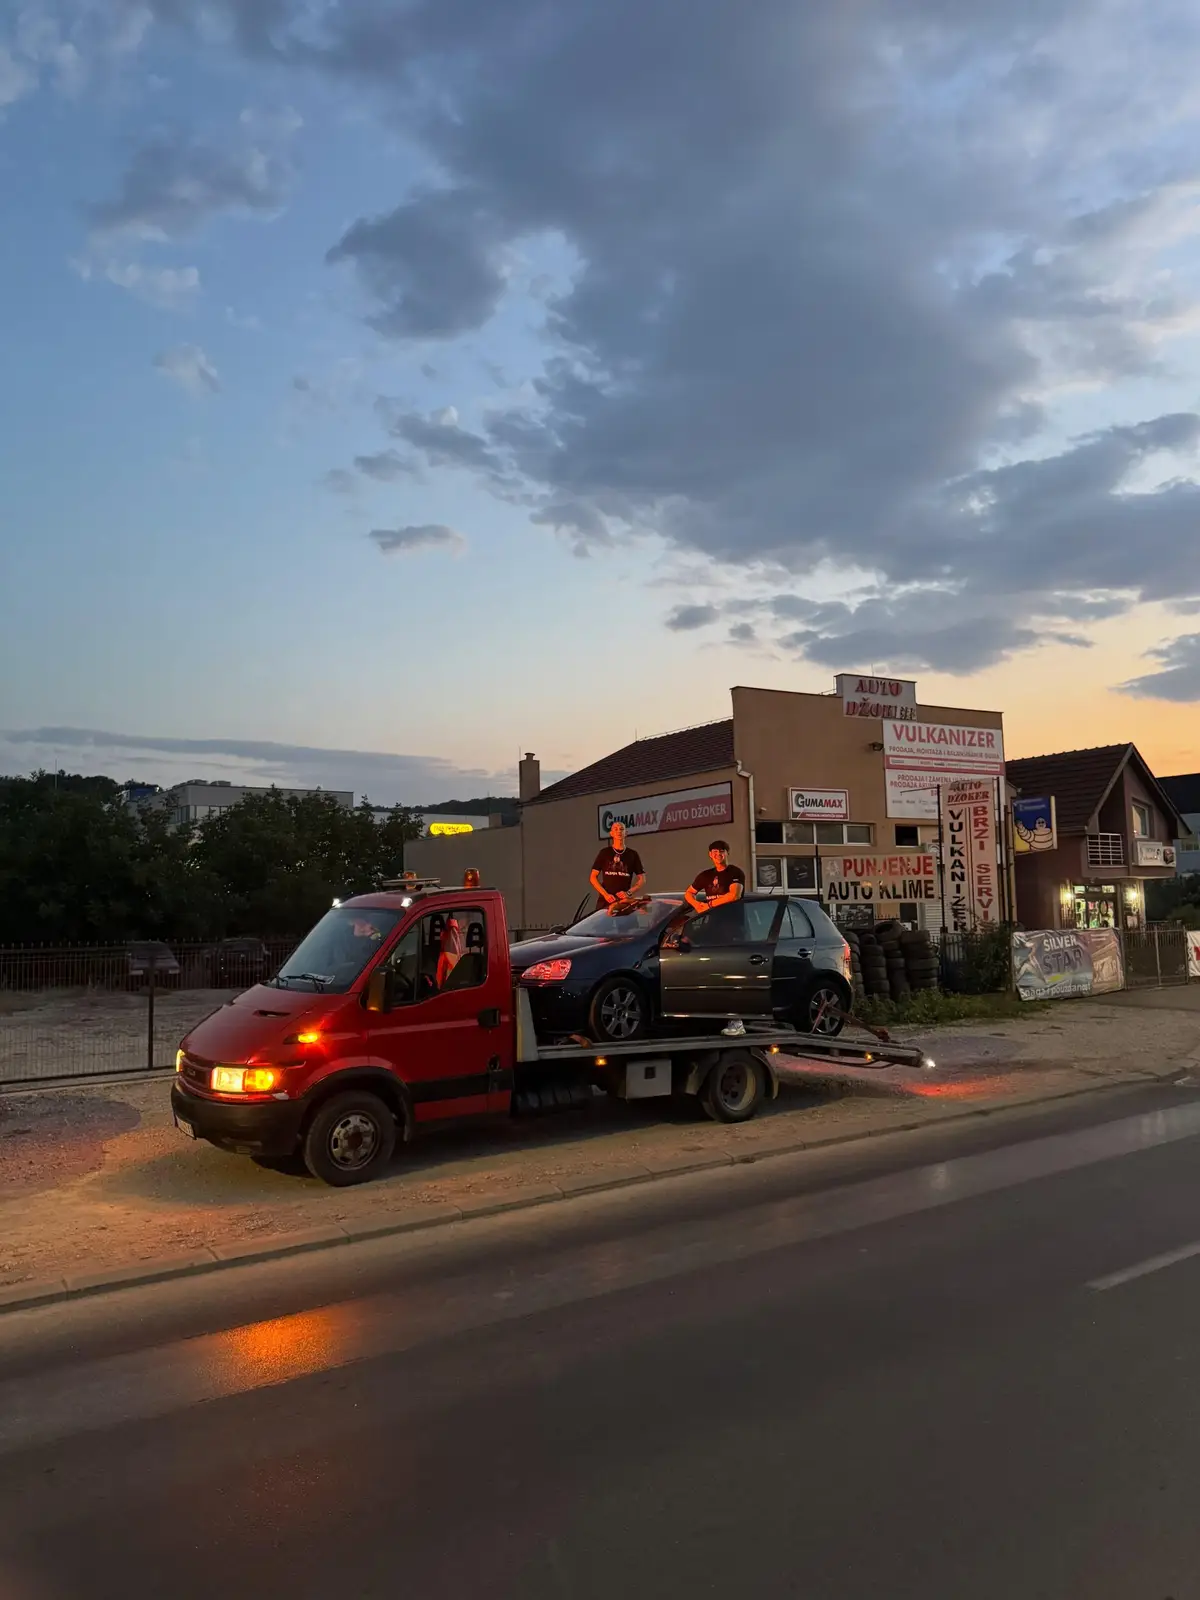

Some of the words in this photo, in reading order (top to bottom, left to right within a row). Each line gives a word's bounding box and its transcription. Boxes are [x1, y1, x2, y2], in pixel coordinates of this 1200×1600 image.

[855, 679, 903, 697] AUTO
[892, 723, 995, 749] VULKANIZER
[890, 780, 917, 789] PRODAJA
[897, 774, 925, 783] PRODAJA
[950, 780, 984, 793] AUTO
[795, 793, 843, 808] GUMAMAX
[947, 791, 990, 804] DŽOKER
[666, 810, 689, 823] AUTO
[691, 803, 727, 818] DŽOKER
[973, 806, 990, 851] BRZI
[843, 856, 934, 877] PUNJENJE
[948, 809, 969, 932] VULKANIZER
[827, 880, 873, 901] AUTO
[879, 879, 935, 900] KLIME
[976, 863, 994, 933] SERVI
[1043, 934, 1078, 952] SILVER
[1042, 948, 1083, 974] STAR
